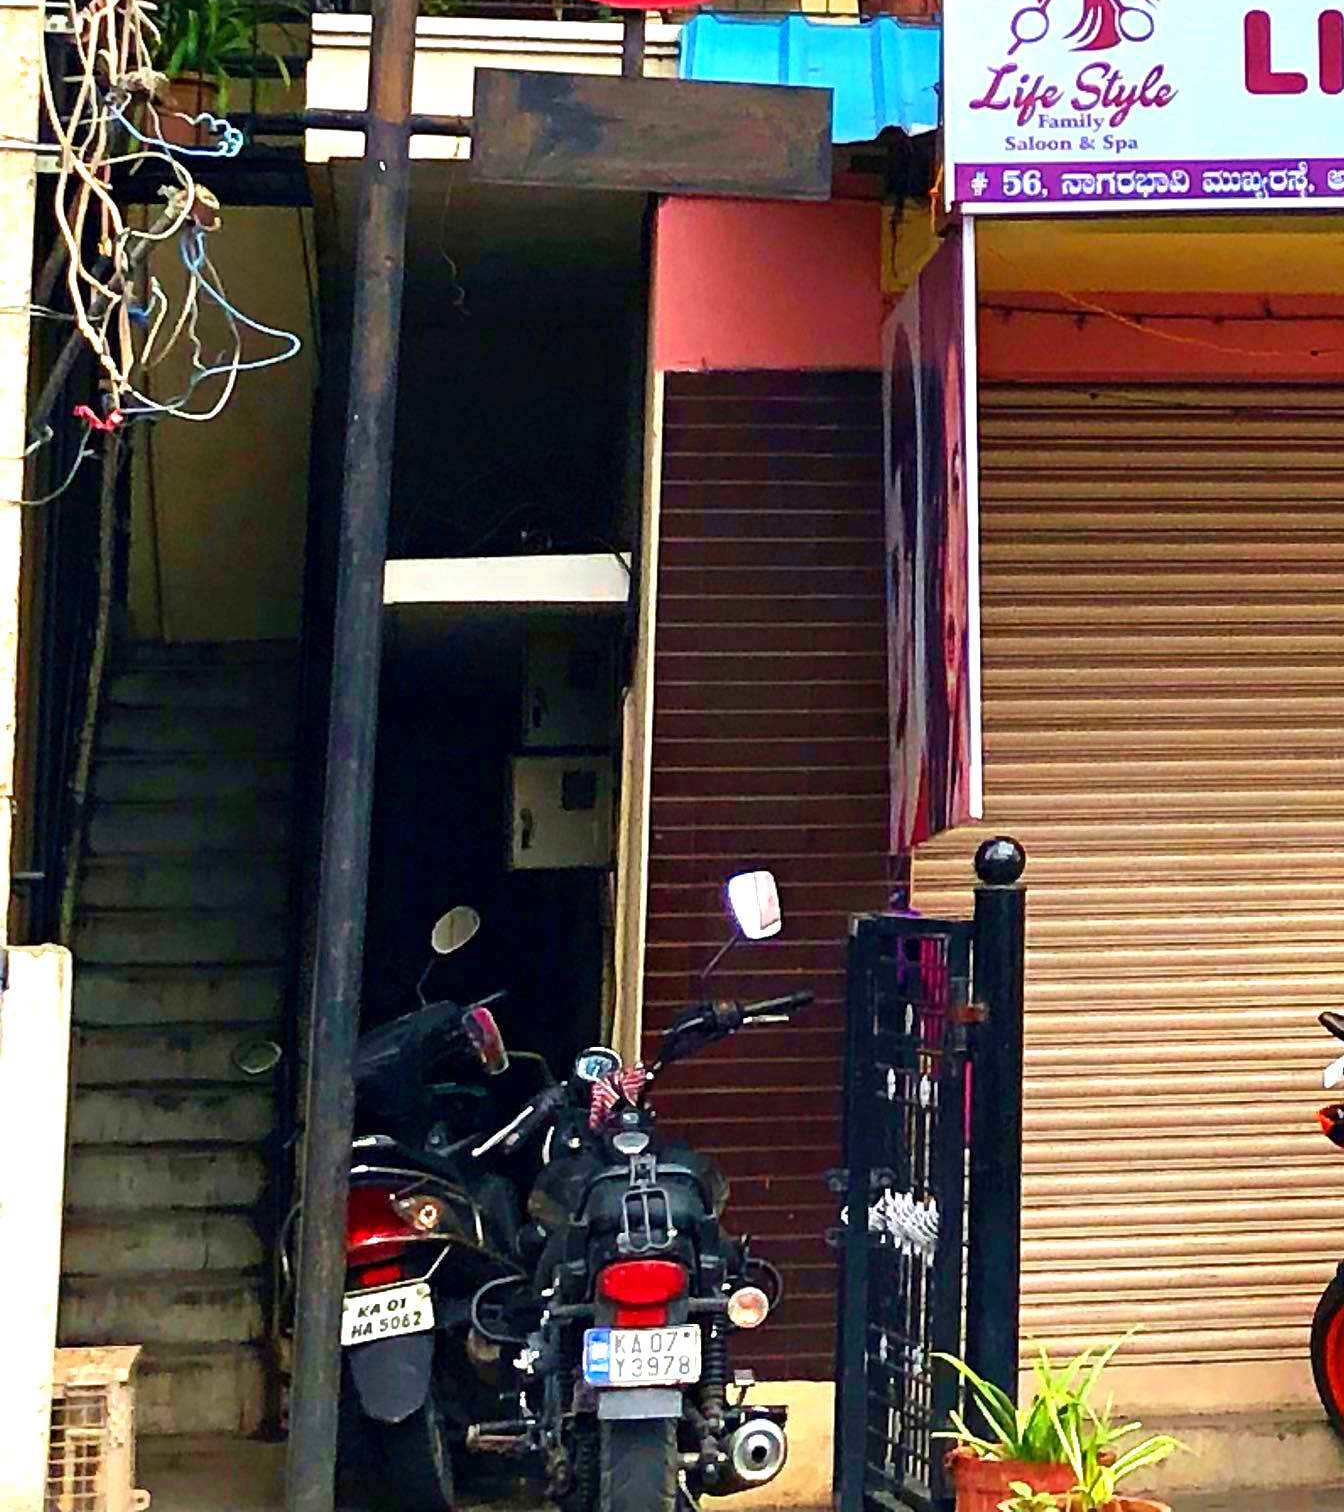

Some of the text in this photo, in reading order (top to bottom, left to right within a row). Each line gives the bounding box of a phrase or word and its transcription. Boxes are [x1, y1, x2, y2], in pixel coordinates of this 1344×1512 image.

[969, 61, 1179, 128] Life Style
[1038, 113, 1105, 133] Family
[1005, 135, 1138, 154] Saloon & Spa
[970, 170, 989, 196] #
[1003, 169, 1048, 198] 56,
[1061, 169, 1190, 198] ನಾಗರಭಾವಿ
[357, 1301, 385, 1318] KA
[351, 1322, 373, 1338] HA
